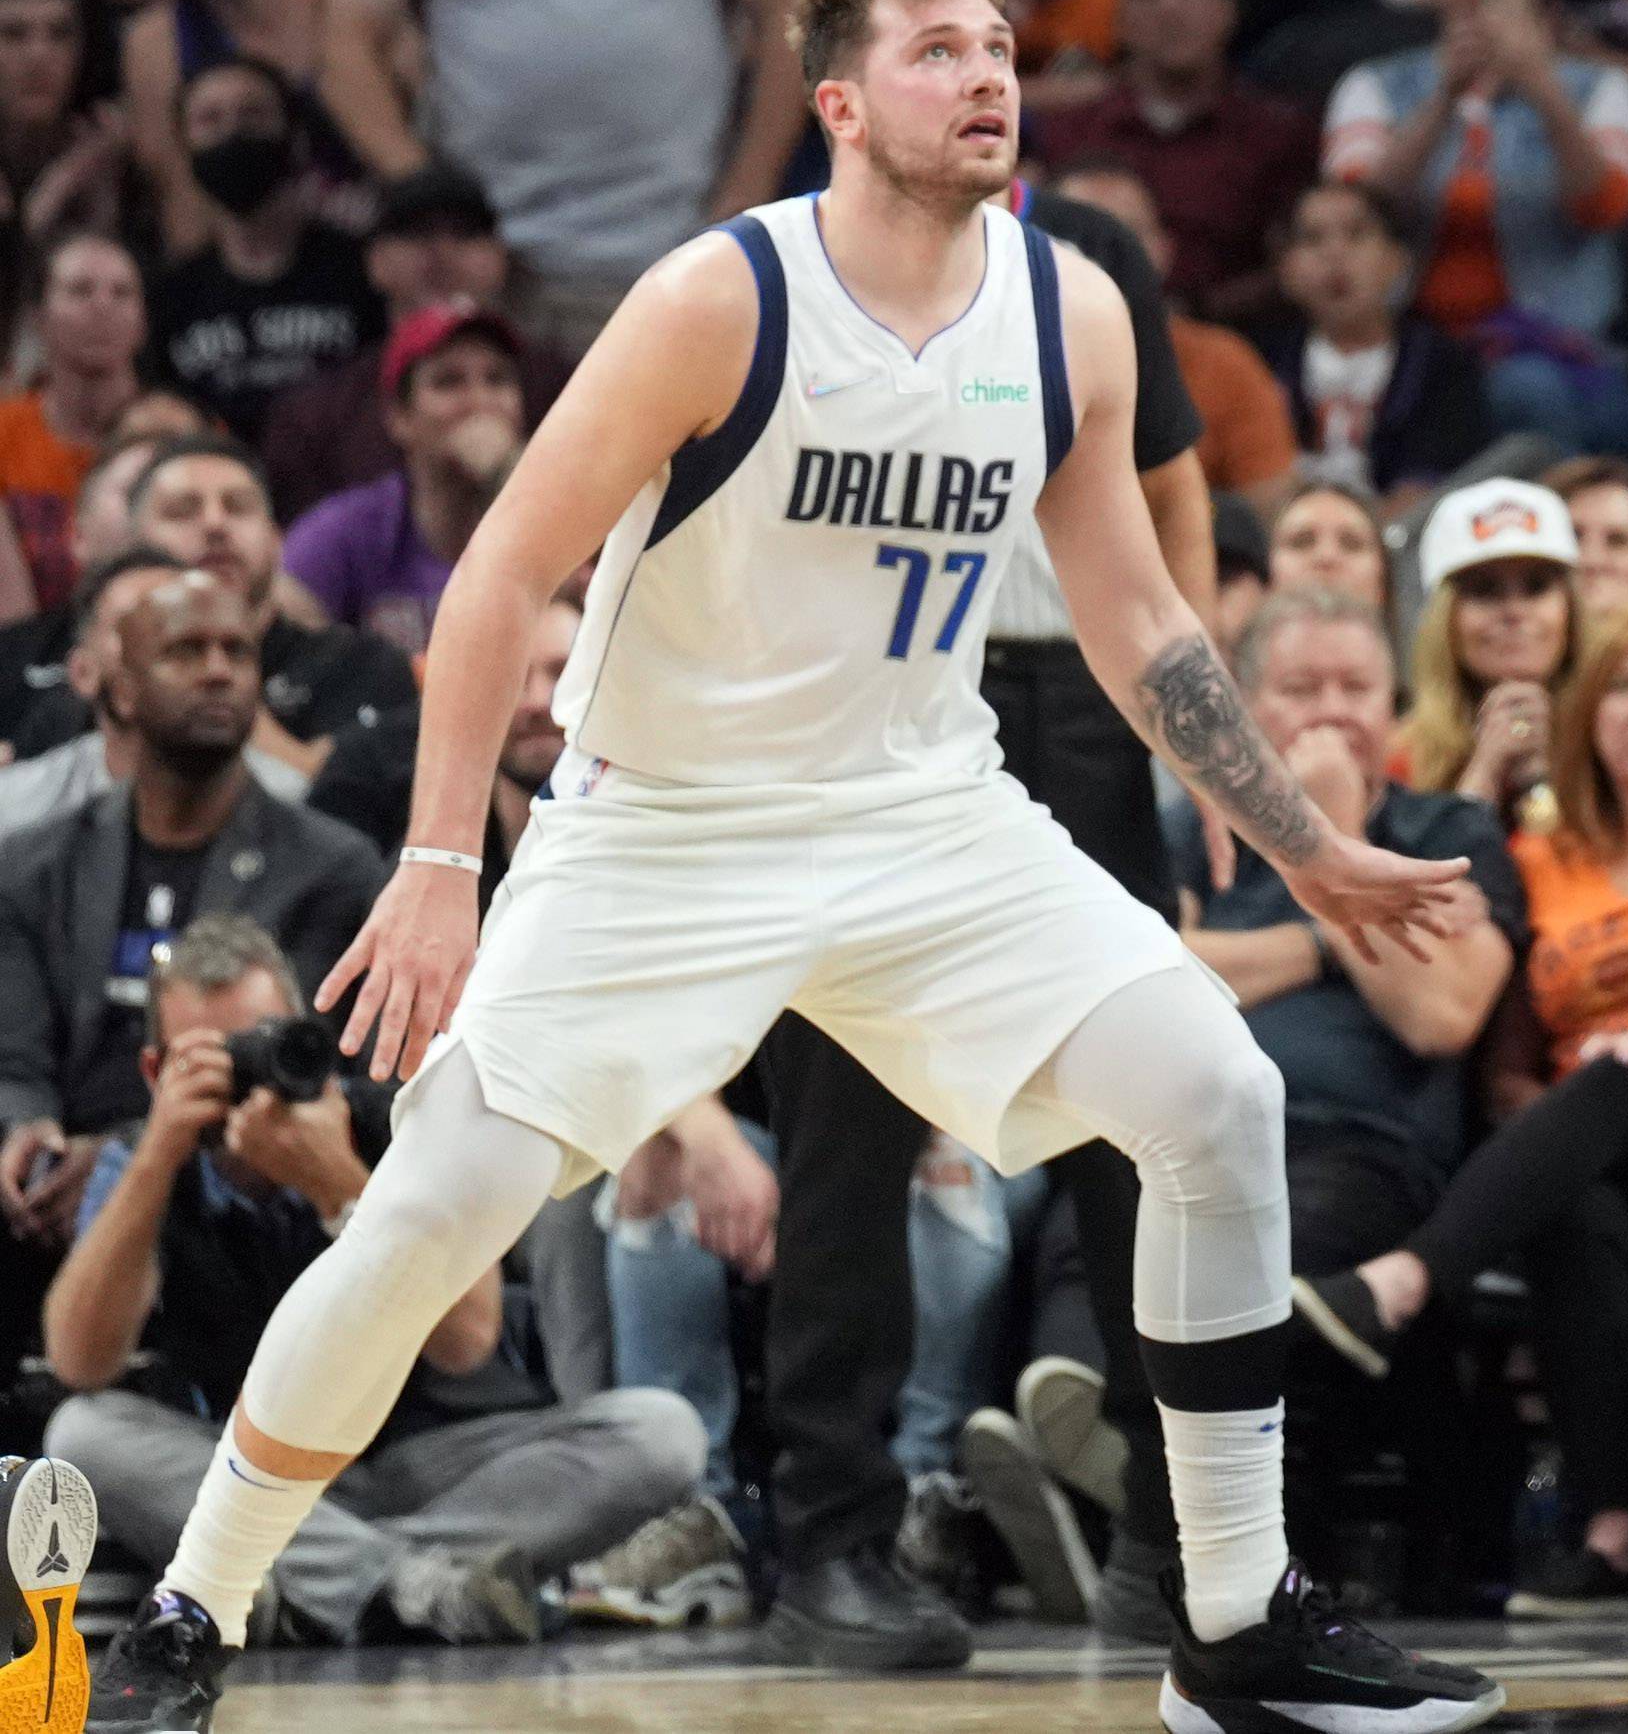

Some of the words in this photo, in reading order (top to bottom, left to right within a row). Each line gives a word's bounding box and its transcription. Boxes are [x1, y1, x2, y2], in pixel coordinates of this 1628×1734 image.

[960, 377, 1031, 405] chime
[784, 446, 1017, 537] DALLAS
[875, 542, 989, 662] 77
